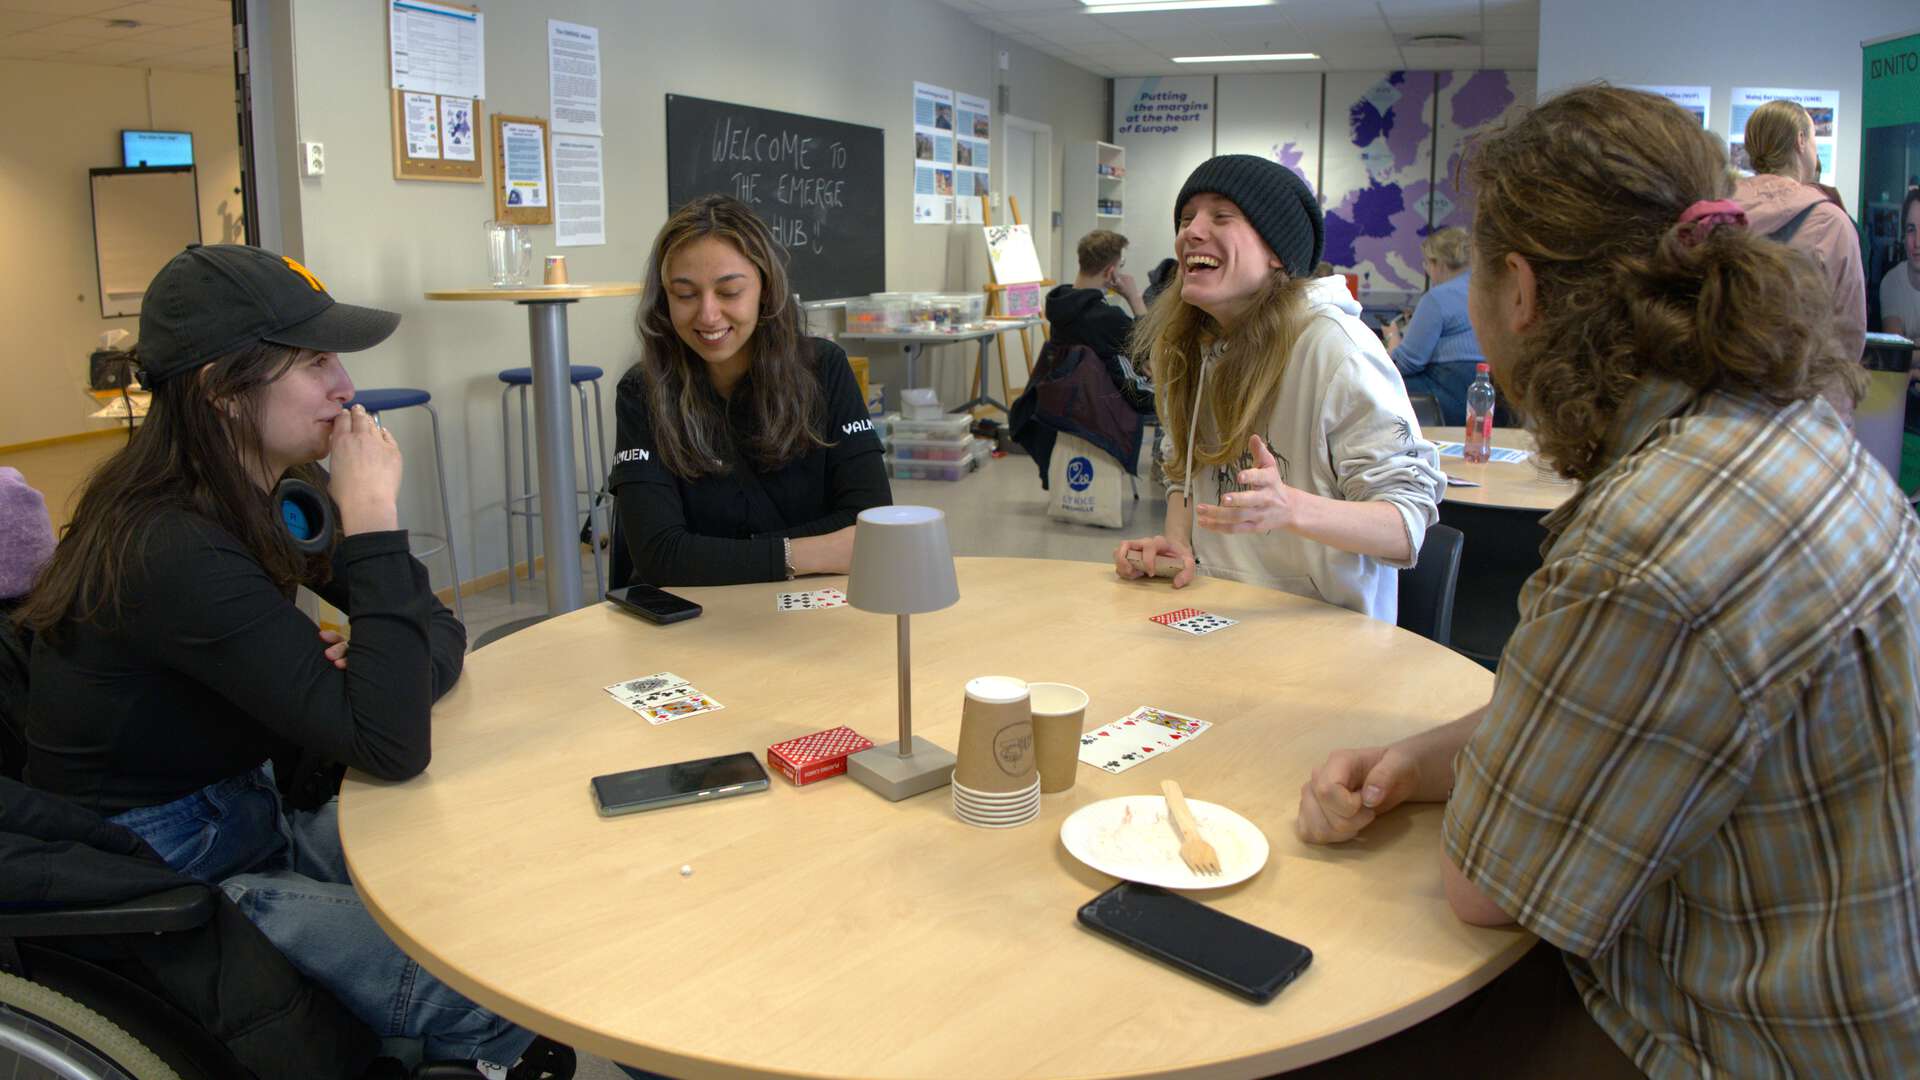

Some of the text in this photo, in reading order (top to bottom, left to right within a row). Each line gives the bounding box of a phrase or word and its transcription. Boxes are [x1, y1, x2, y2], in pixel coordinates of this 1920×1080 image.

[1884, 52, 1919, 77] NITO
[1141, 91, 1188, 102] Putting
[1133, 101, 1208, 112] the margins
[1126, 113, 1200, 123] at the heart
[1118, 124, 1179, 134] of Europe
[712, 117, 847, 170] WELCOME TO
[731, 172, 845, 209] THE EMERGE
[771, 214, 808, 247] HUB
